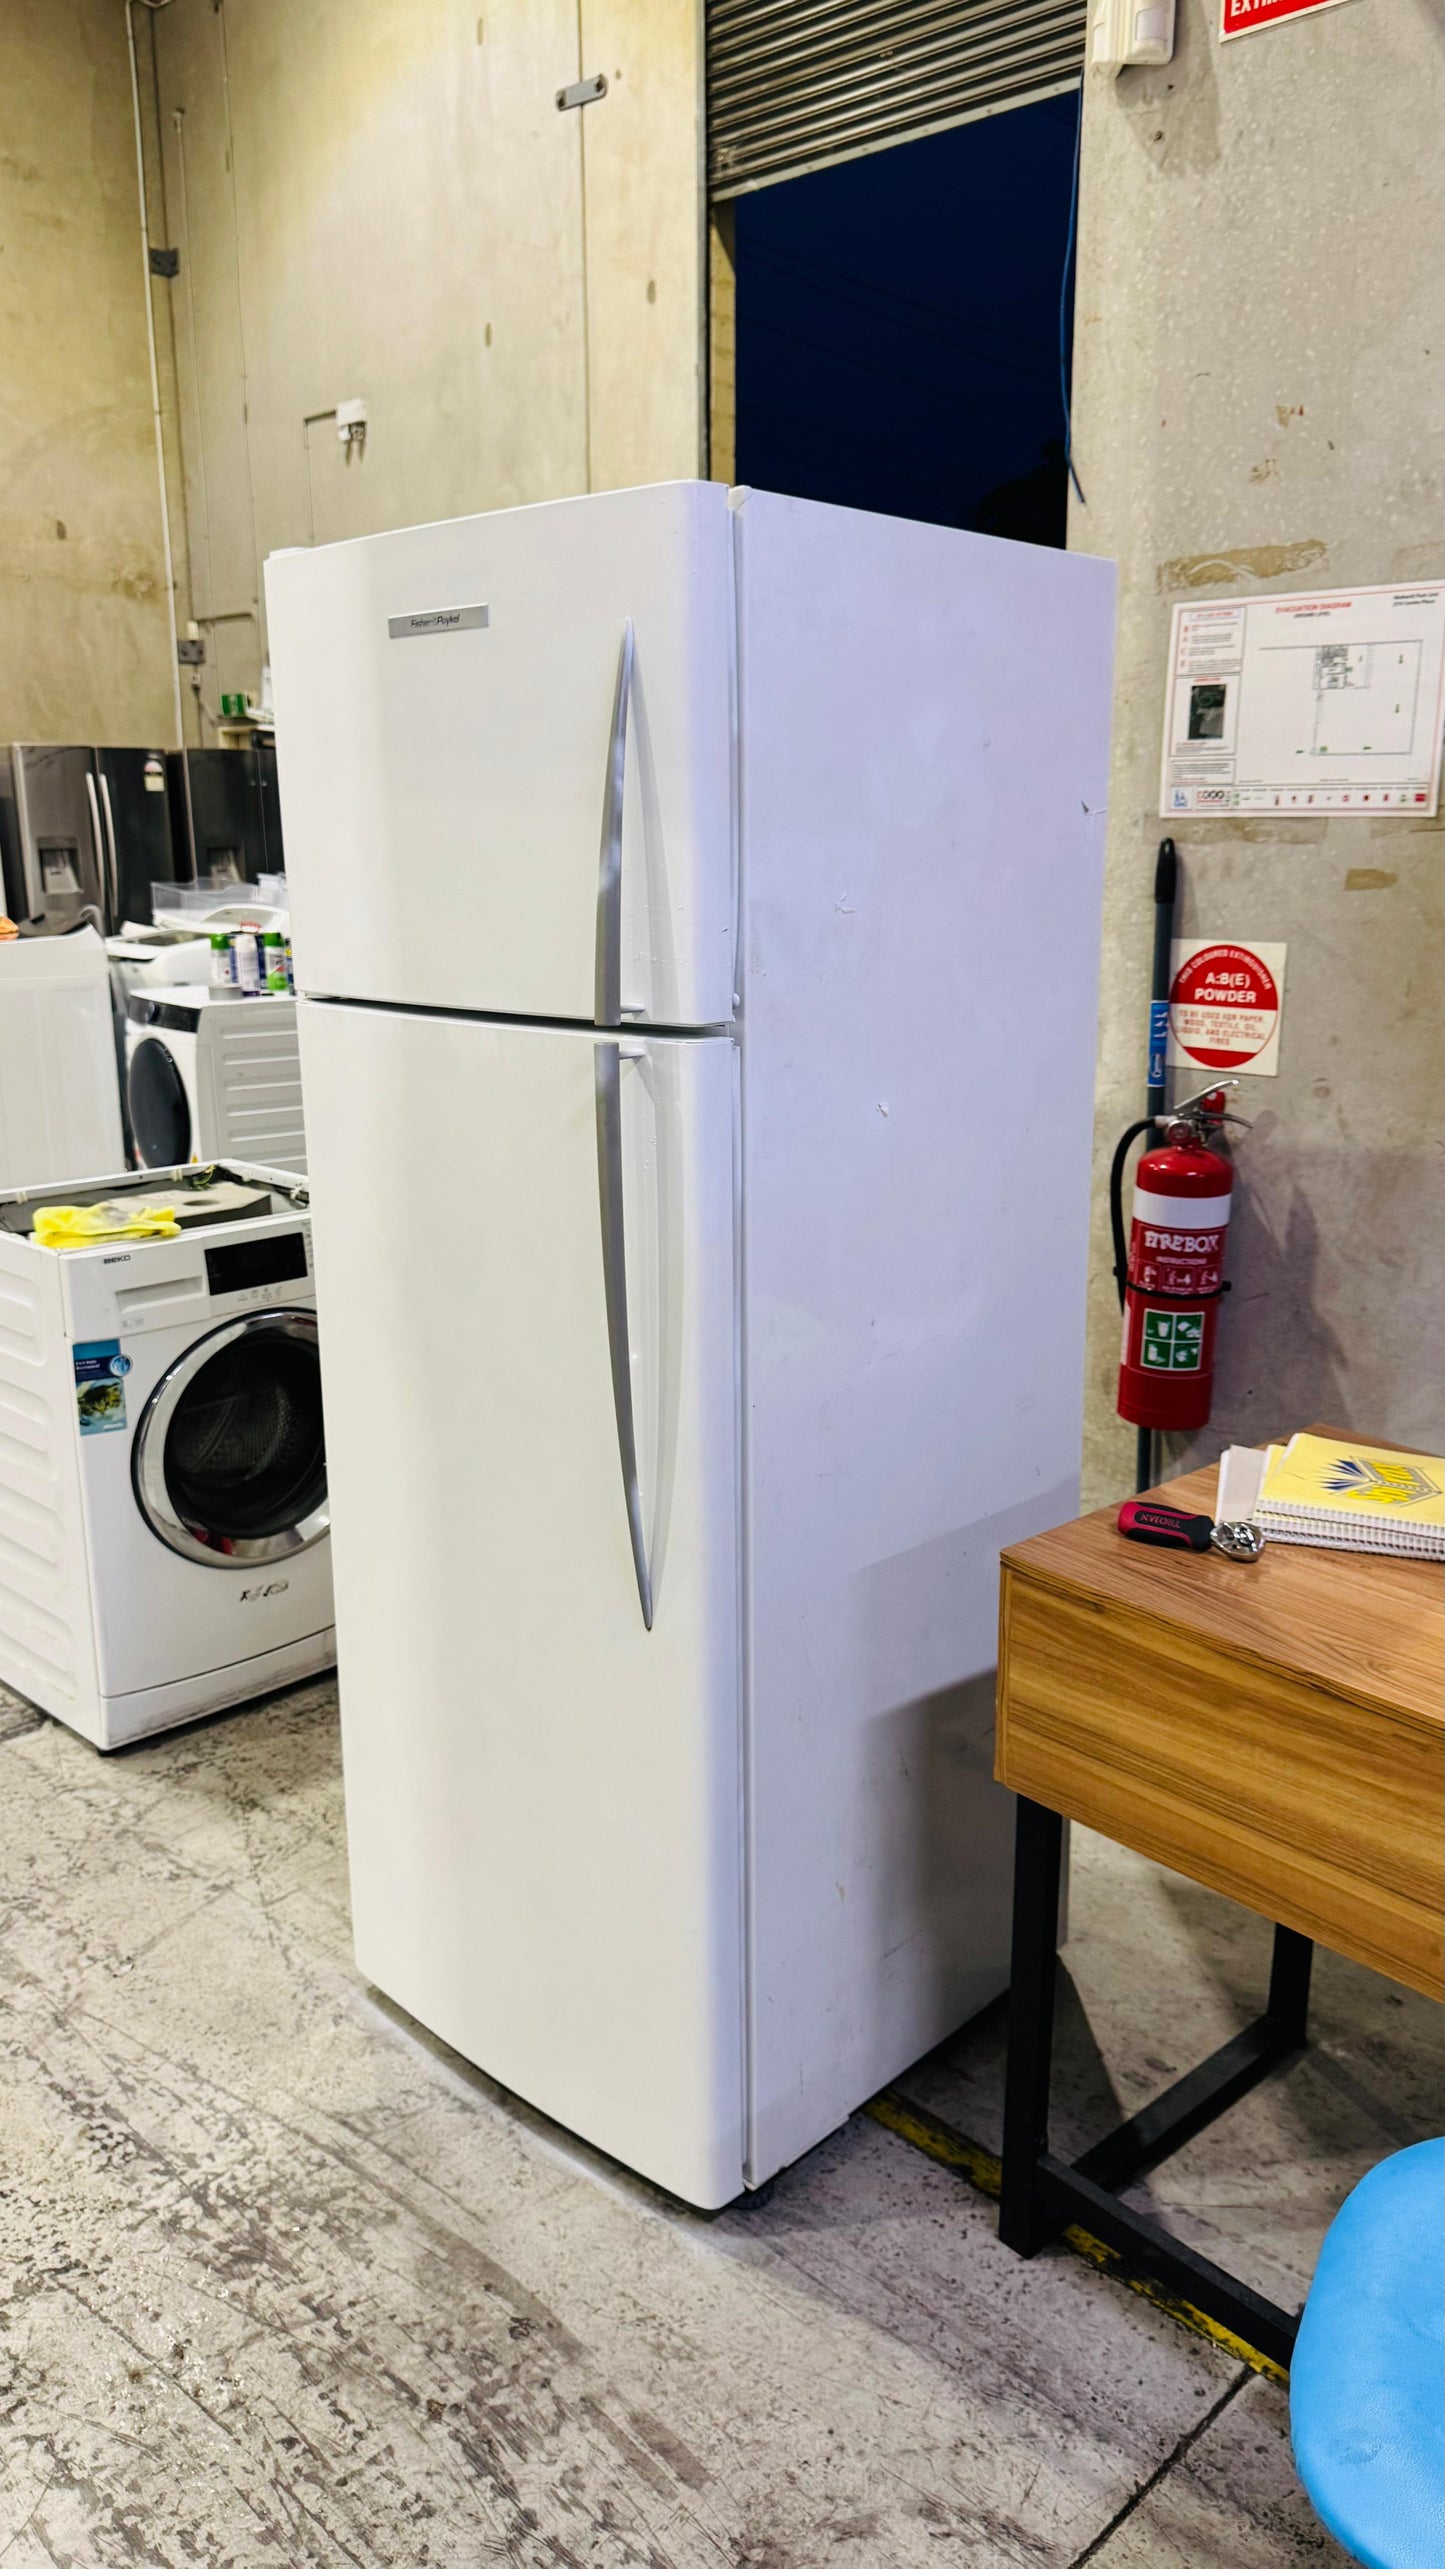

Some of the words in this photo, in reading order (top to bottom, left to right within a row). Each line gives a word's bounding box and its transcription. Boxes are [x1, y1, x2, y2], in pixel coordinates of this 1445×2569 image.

[1205, 972, 1251, 989] A:B(E)
[1194, 988, 1257, 1003] POWDER
[1144, 1230, 1219, 1253] FIREBOX
[103, 1255, 131, 1264] BEKO
[1140, 1512, 1182, 1529] TROJAN
